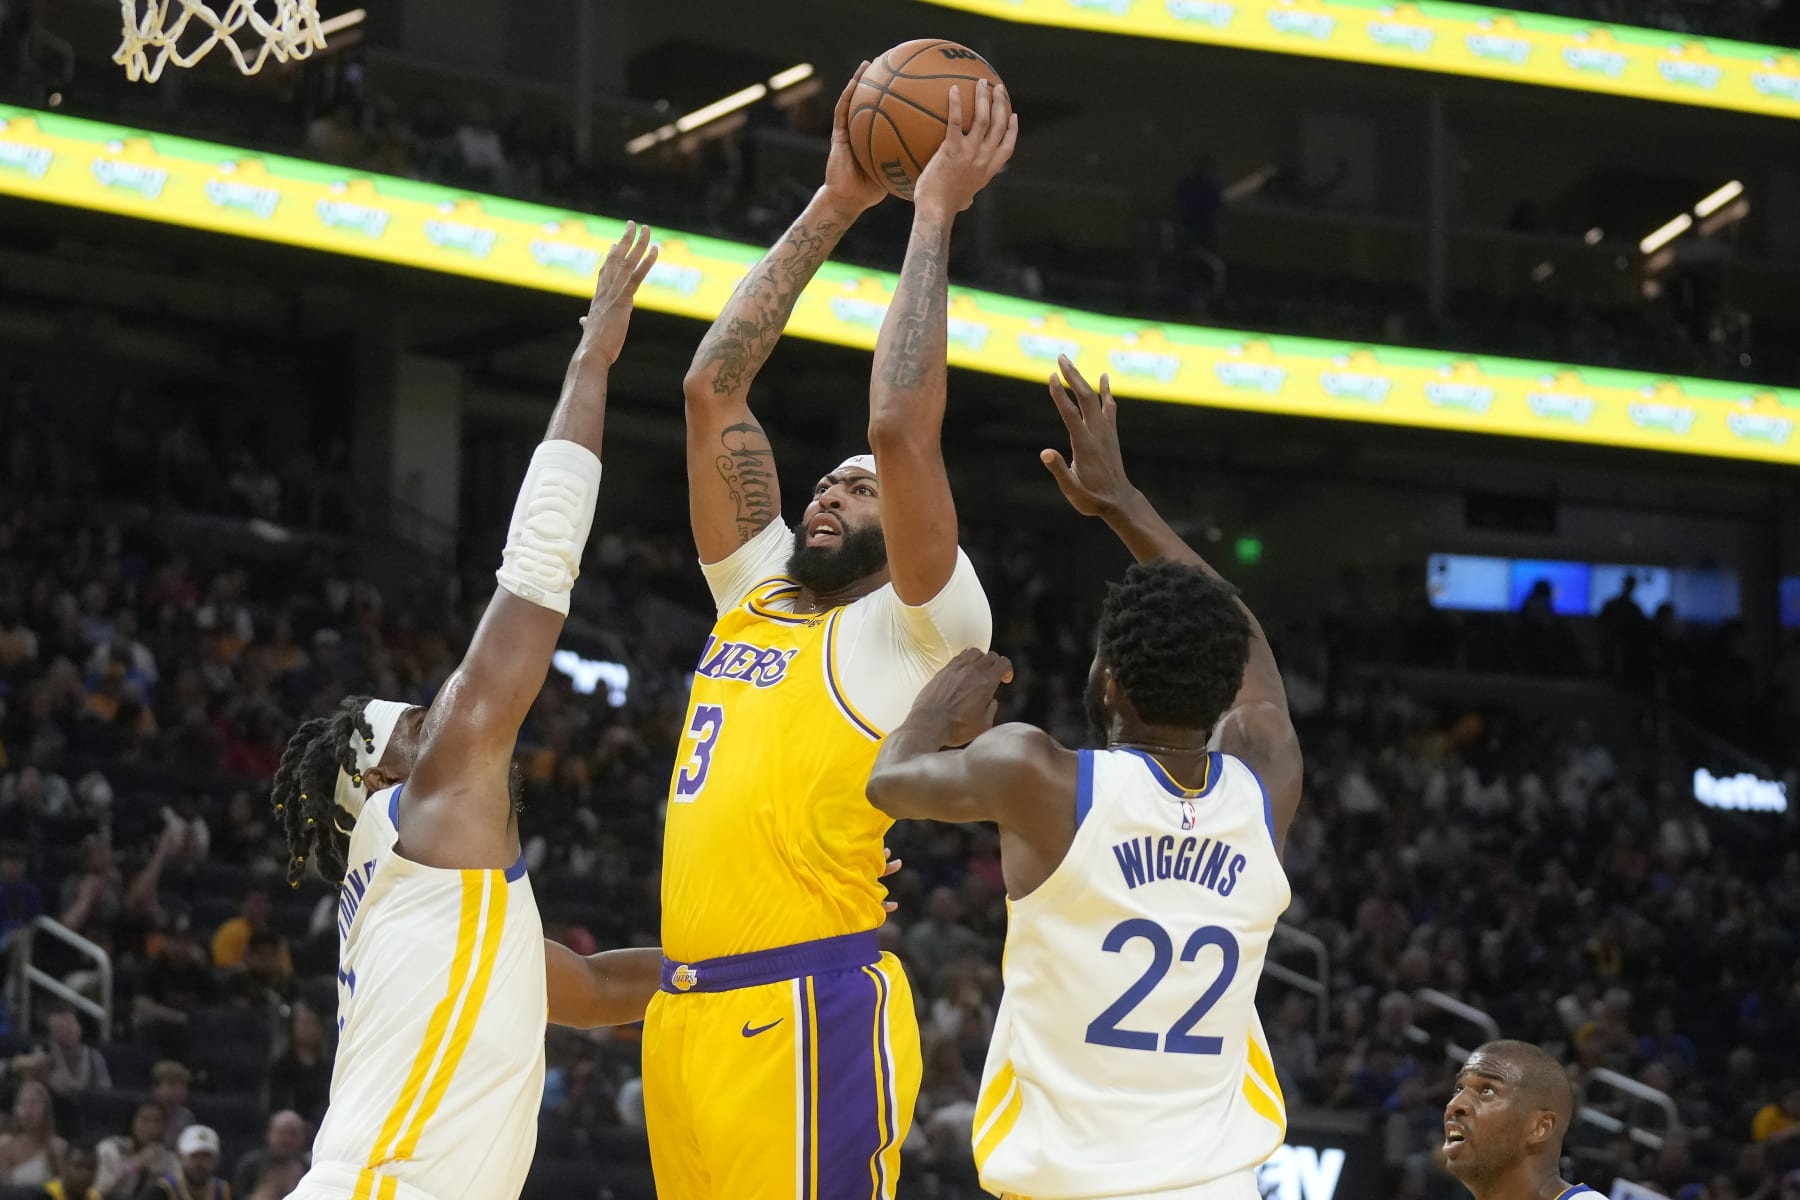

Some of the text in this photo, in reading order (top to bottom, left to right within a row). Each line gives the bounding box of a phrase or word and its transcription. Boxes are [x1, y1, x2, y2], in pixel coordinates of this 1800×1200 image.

[674, 703, 725, 803] 3
[1112, 834, 1247, 897] WIGGINS
[1085, 917, 1240, 1056] 22
